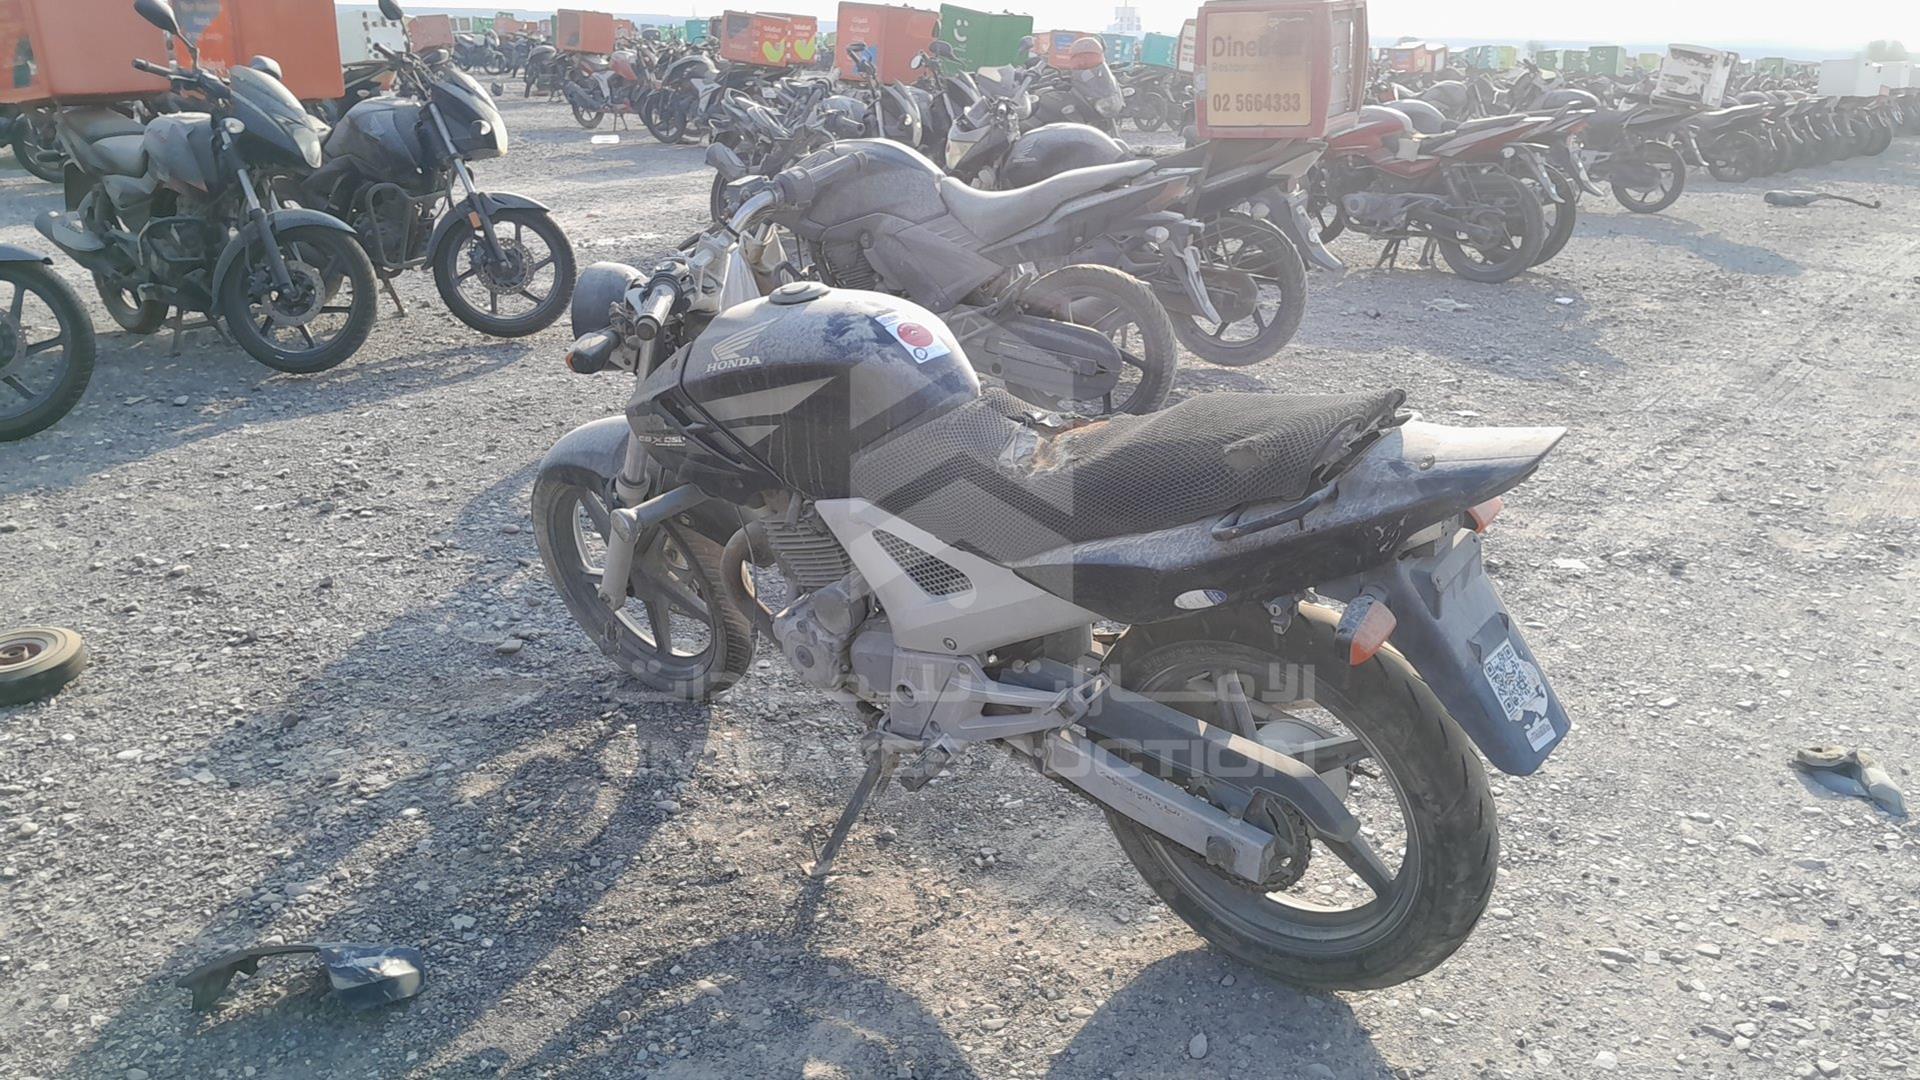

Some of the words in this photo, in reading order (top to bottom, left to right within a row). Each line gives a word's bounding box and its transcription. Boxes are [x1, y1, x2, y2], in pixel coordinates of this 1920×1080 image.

[1212, 93, 1231, 112] 02
[1235, 93, 1301, 112] 5664333
[704, 355, 762, 373] HONDA
